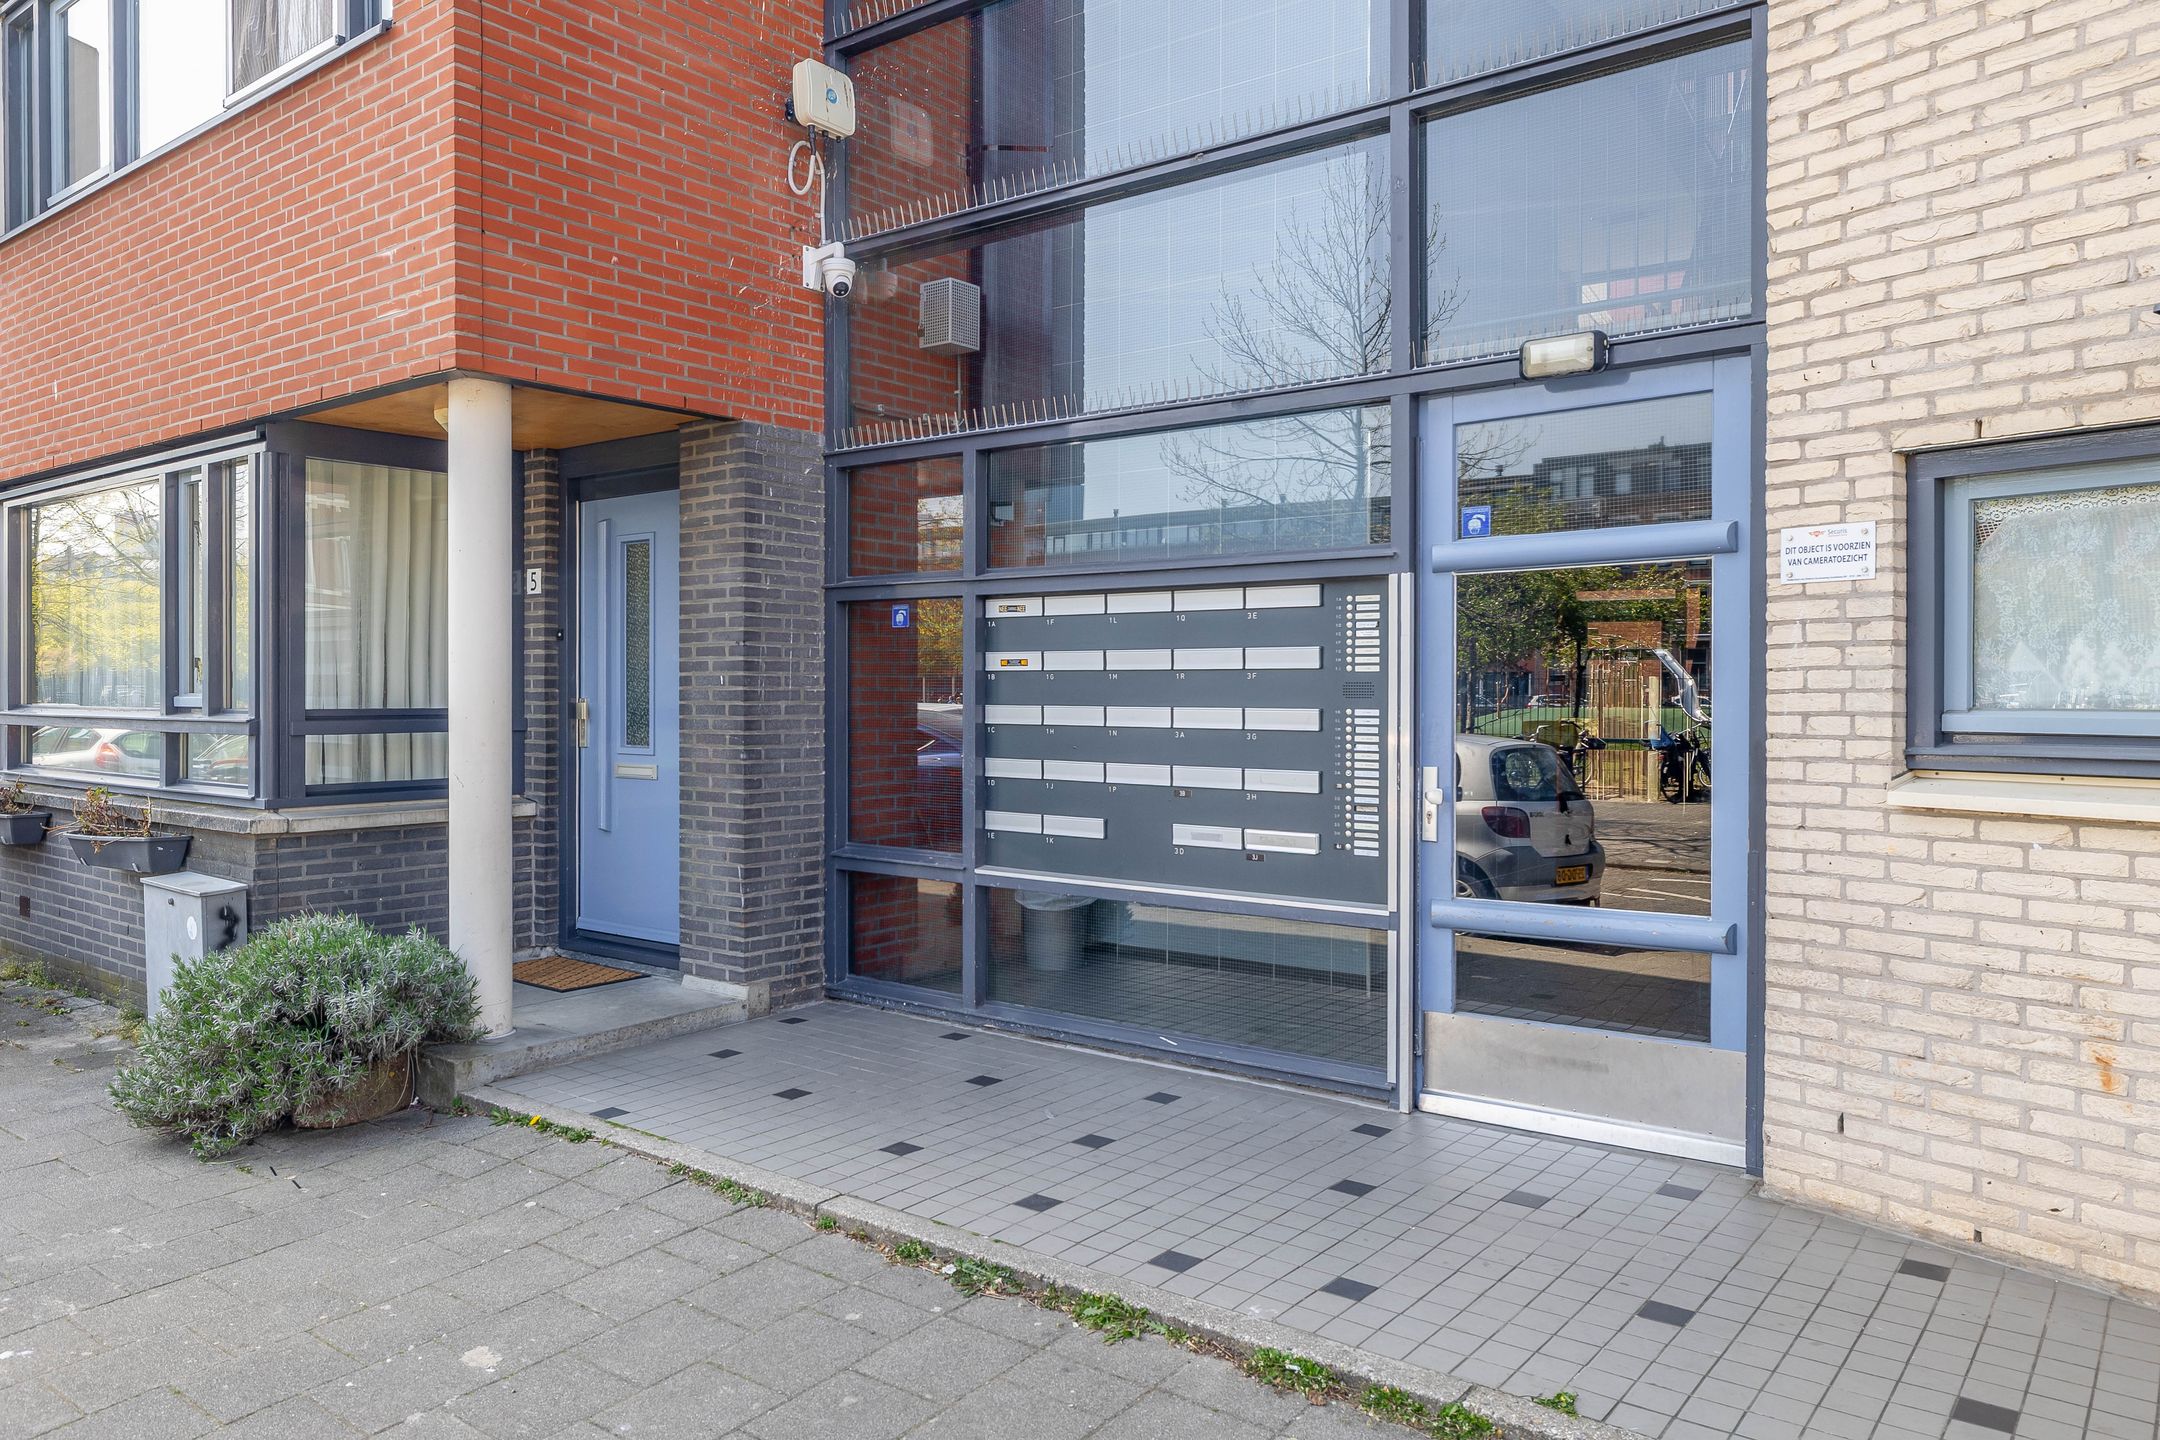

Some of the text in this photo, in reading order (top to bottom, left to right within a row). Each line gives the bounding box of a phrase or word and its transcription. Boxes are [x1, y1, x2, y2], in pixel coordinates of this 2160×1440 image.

[1785, 541, 1871, 555] DIT OBJECT IS VOORZIEN
[1787, 553, 1868, 566] VAN CAMERATOEZICHT
[530, 571, 537, 591] 5
